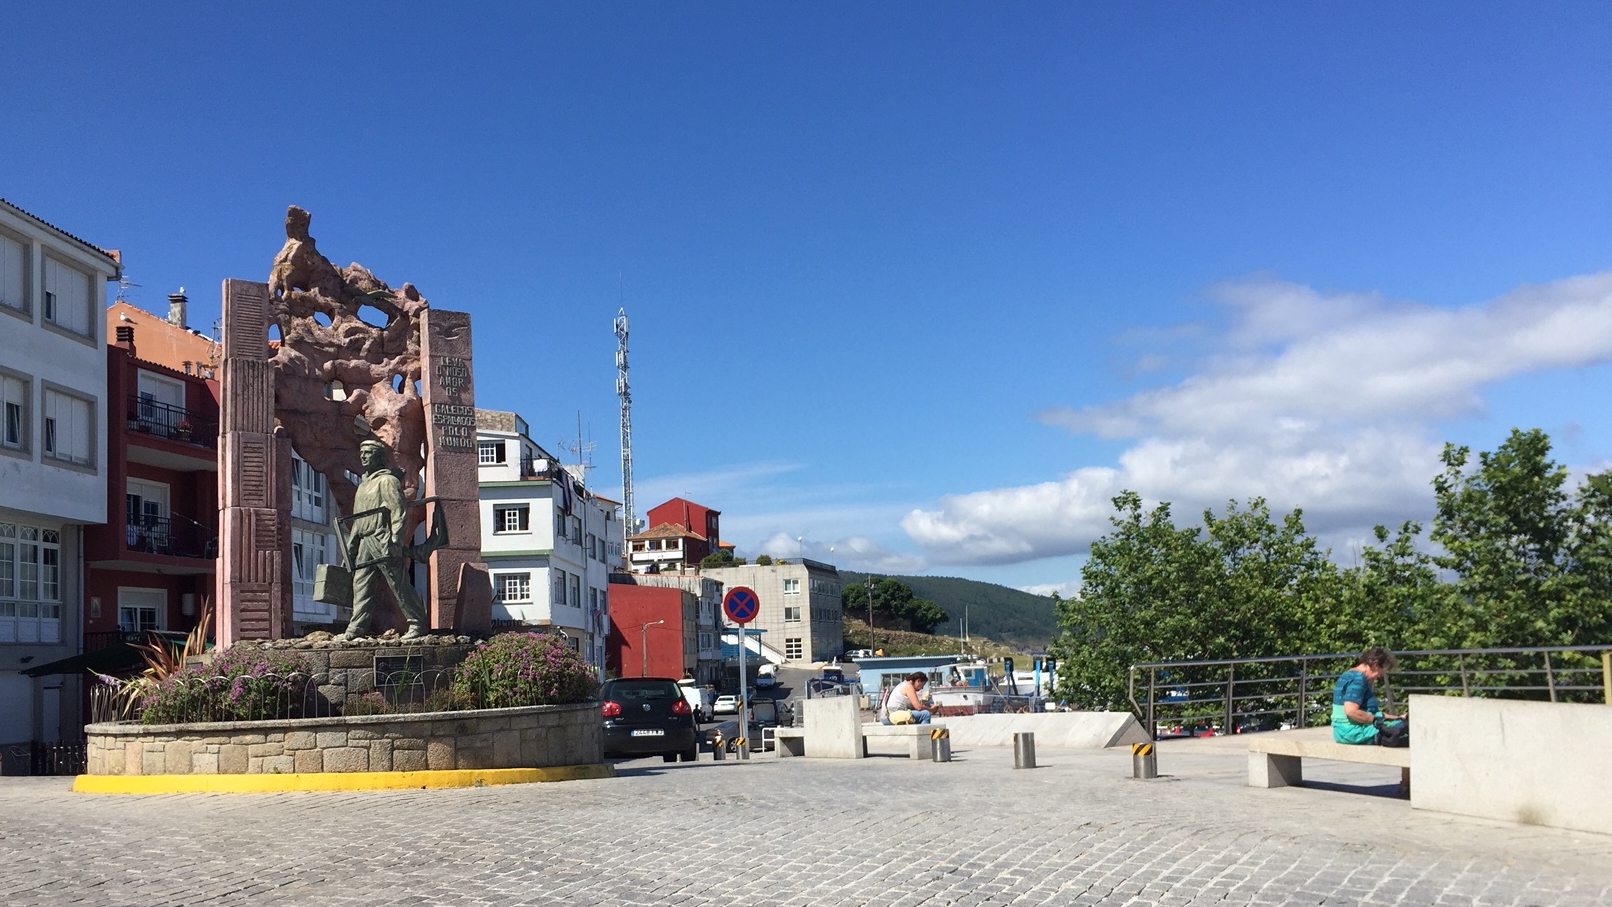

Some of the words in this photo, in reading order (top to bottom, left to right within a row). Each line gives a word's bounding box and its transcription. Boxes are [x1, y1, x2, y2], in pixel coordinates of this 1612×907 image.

[441, 357, 463, 367] LEVA
[436, 365, 442, 374] O
[446, 366, 467, 377] NOSO
[440, 377, 464, 387] AMOR
[445, 387, 458, 396] OS
[435, 405, 472, 415] GALEGOS
[442, 427, 467, 436] POLO
[440, 437, 472, 447] MUNDO
